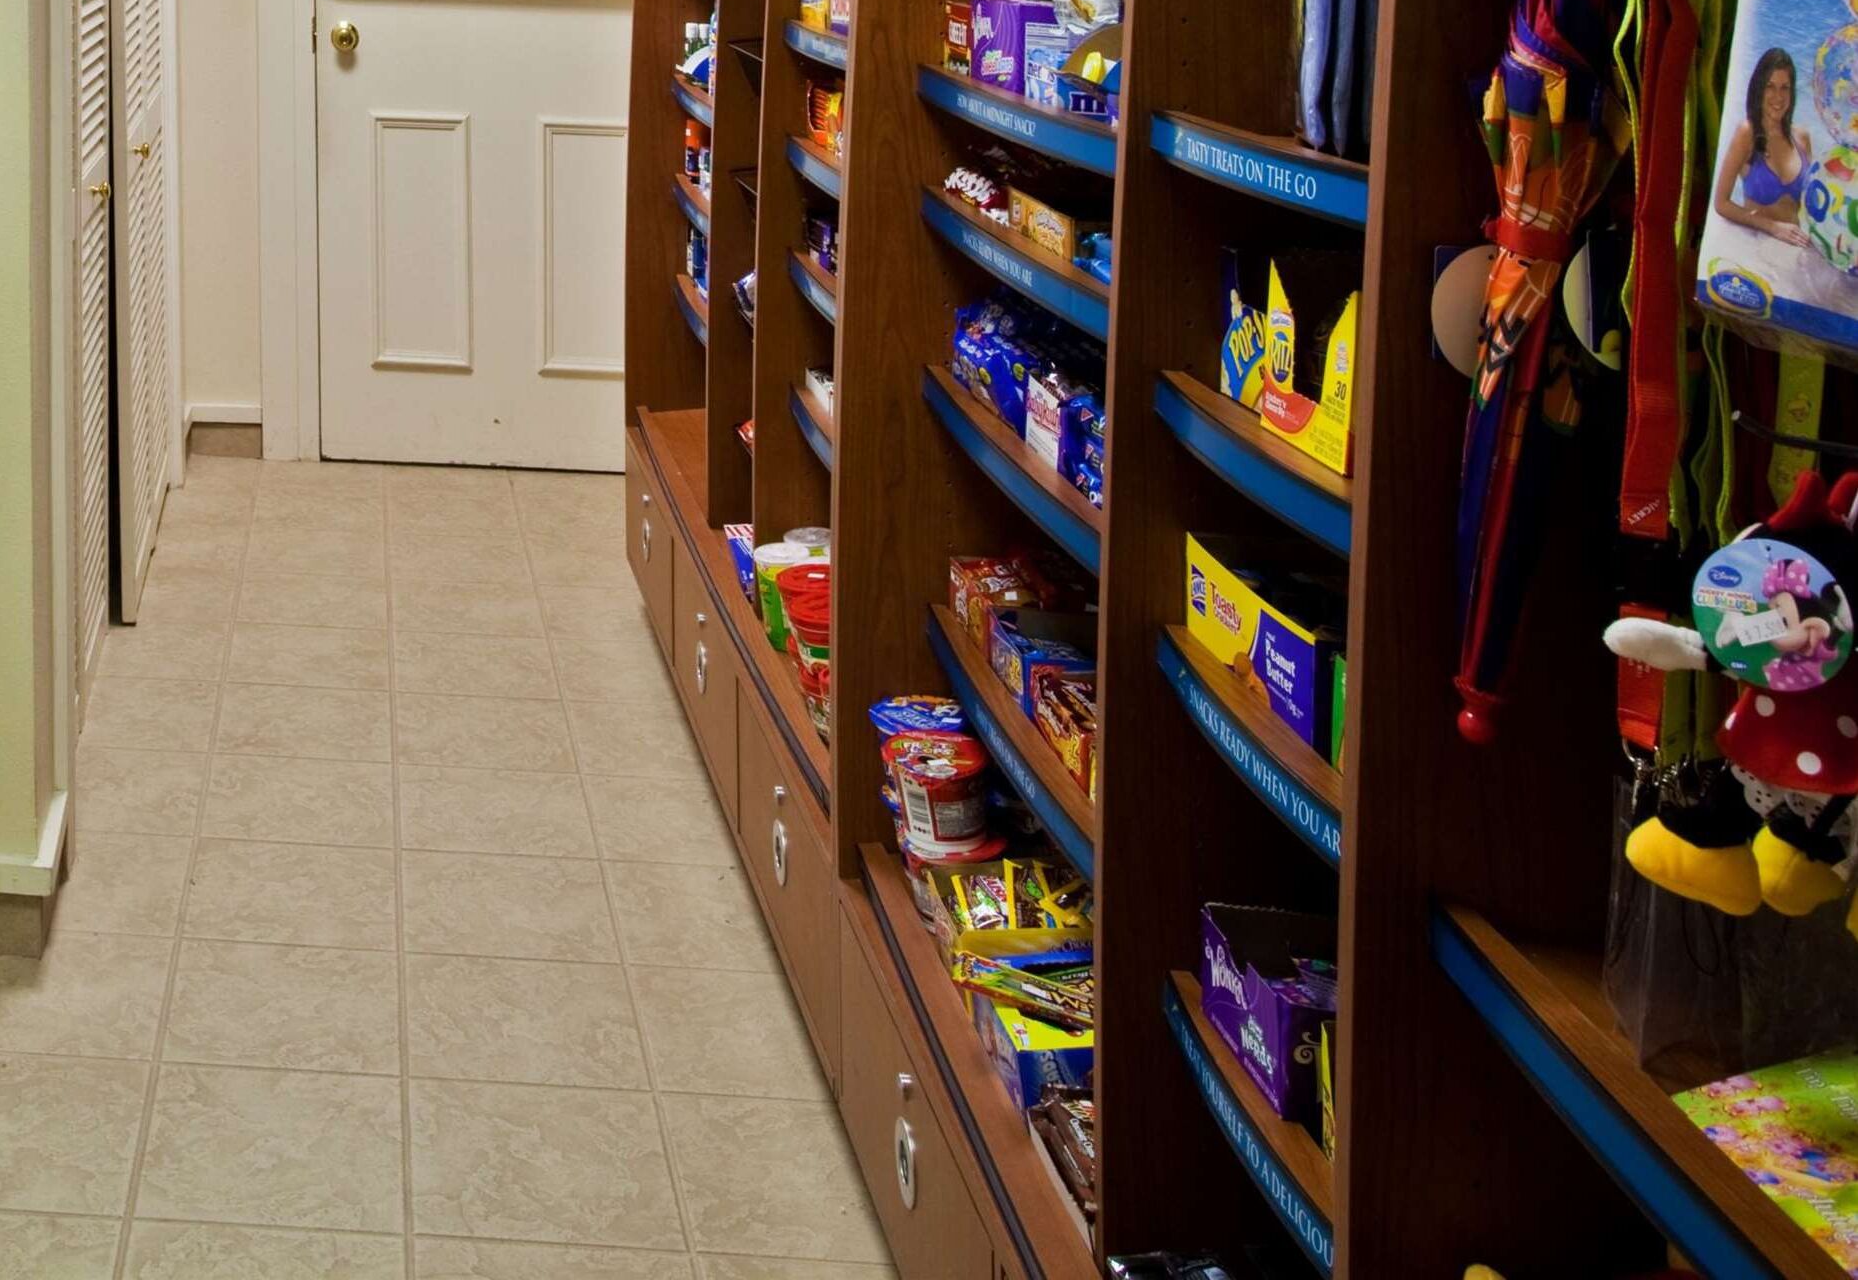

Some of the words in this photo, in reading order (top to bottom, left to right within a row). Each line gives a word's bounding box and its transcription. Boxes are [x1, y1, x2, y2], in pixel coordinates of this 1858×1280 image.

[1187, 138, 1210, 163] TASTY
[1211, 146, 1244, 178] TREATS
[1245, 158, 1264, 183] ON
[1266, 164, 1291, 193] THE
[1294, 173, 1317, 199] GO
[1334, 380, 1347, 401] 30
[1210, 581, 1242, 632] Toasty
[1264, 638, 1296, 678] Peanut
[1265, 658, 1294, 695] Butter
[1189, 685, 1219, 735] SNACKS
[1220, 717, 1251, 769] READY
[1252, 753, 1288, 807] WHEN
[1291, 792, 1320, 835] YOU
[1322, 823, 1341, 857] AR
[1201, 1070, 1244, 1145] YOURSELF
[1244, 1133, 1260, 1169] TO
[1263, 1161, 1270, 1185] A
[1271, 1171, 1334, 1269] DELICIOU
